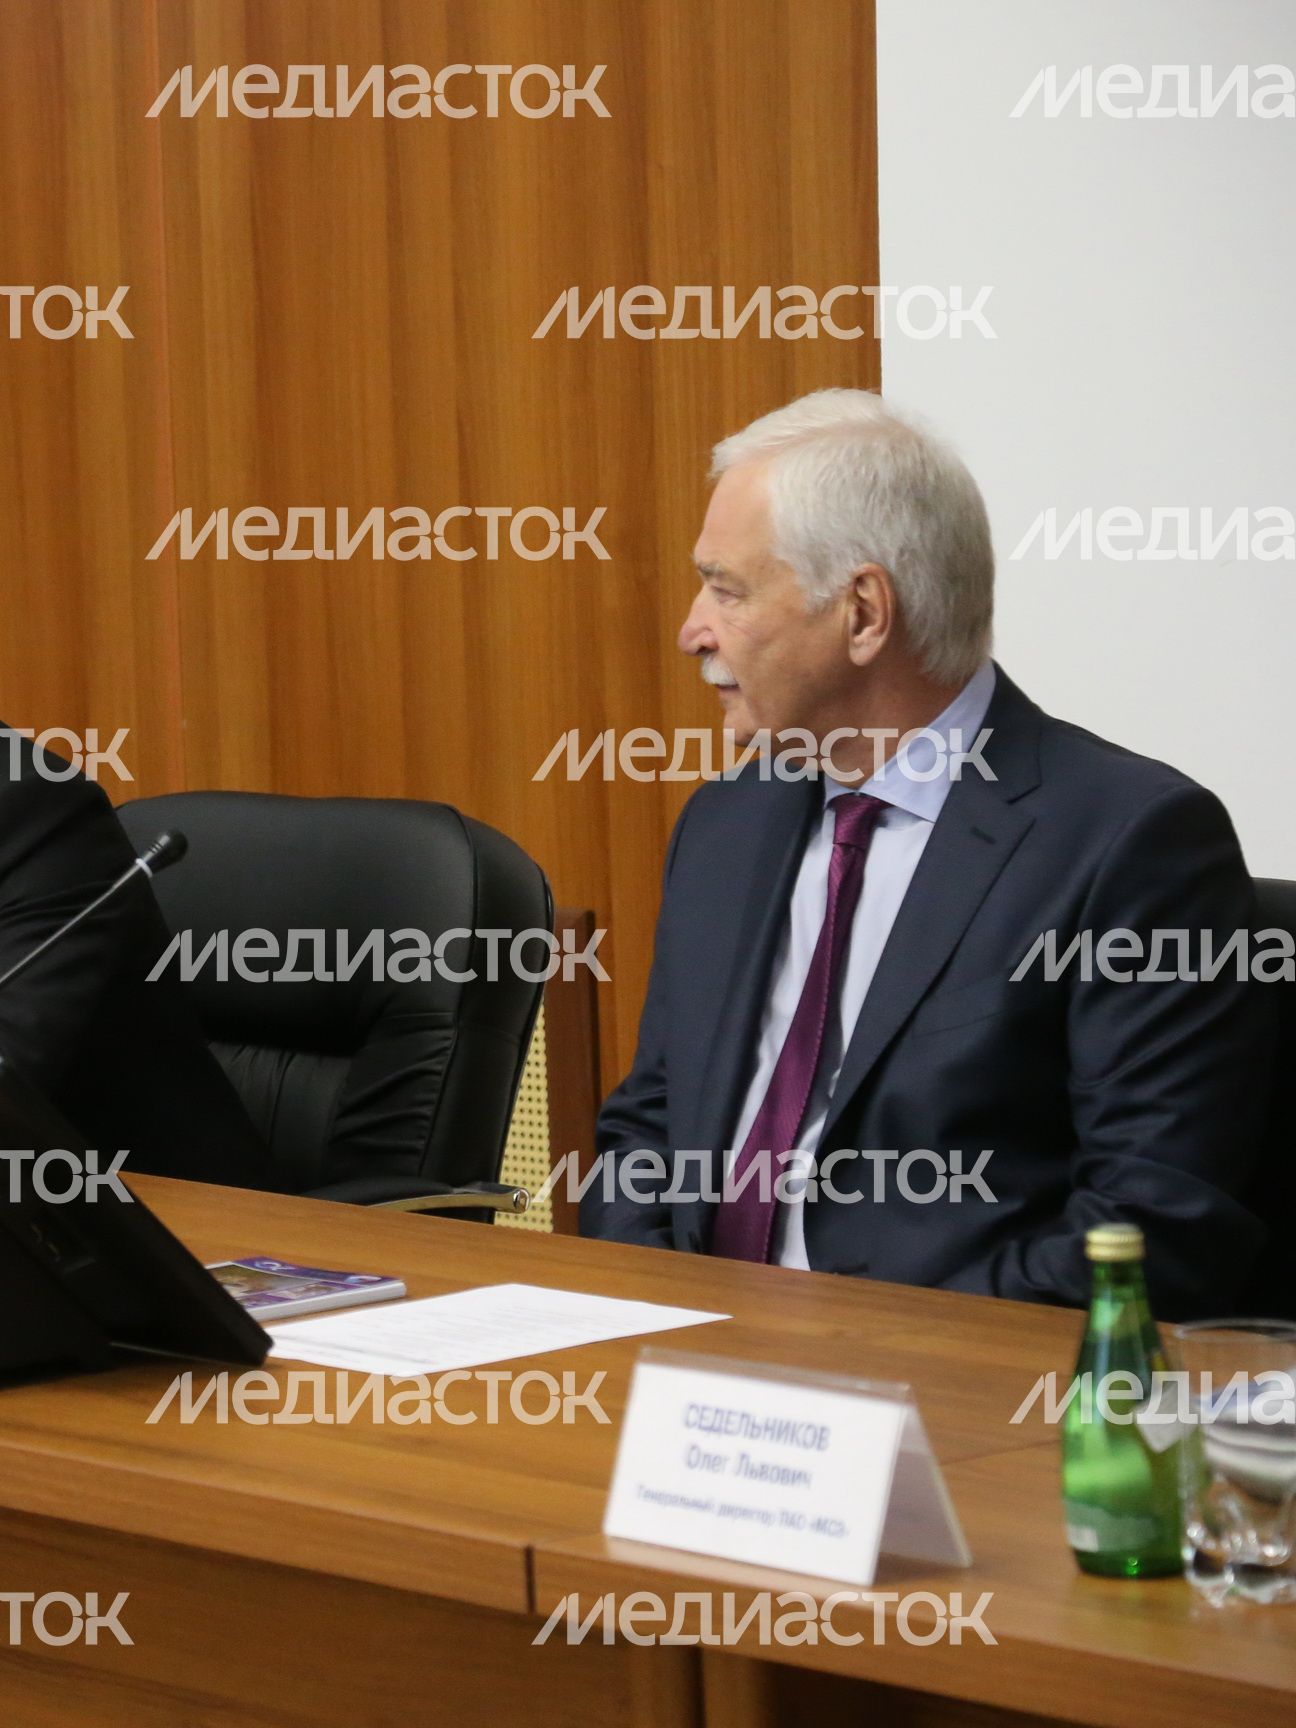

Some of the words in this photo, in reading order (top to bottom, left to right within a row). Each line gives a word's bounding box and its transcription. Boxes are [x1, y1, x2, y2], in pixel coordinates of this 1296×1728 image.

[683, 1402, 831, 1451] СЕДЕЛЬНИКОВ
[685, 1443, 731, 1475] Олег
[734, 1452, 812, 1489] Львович
